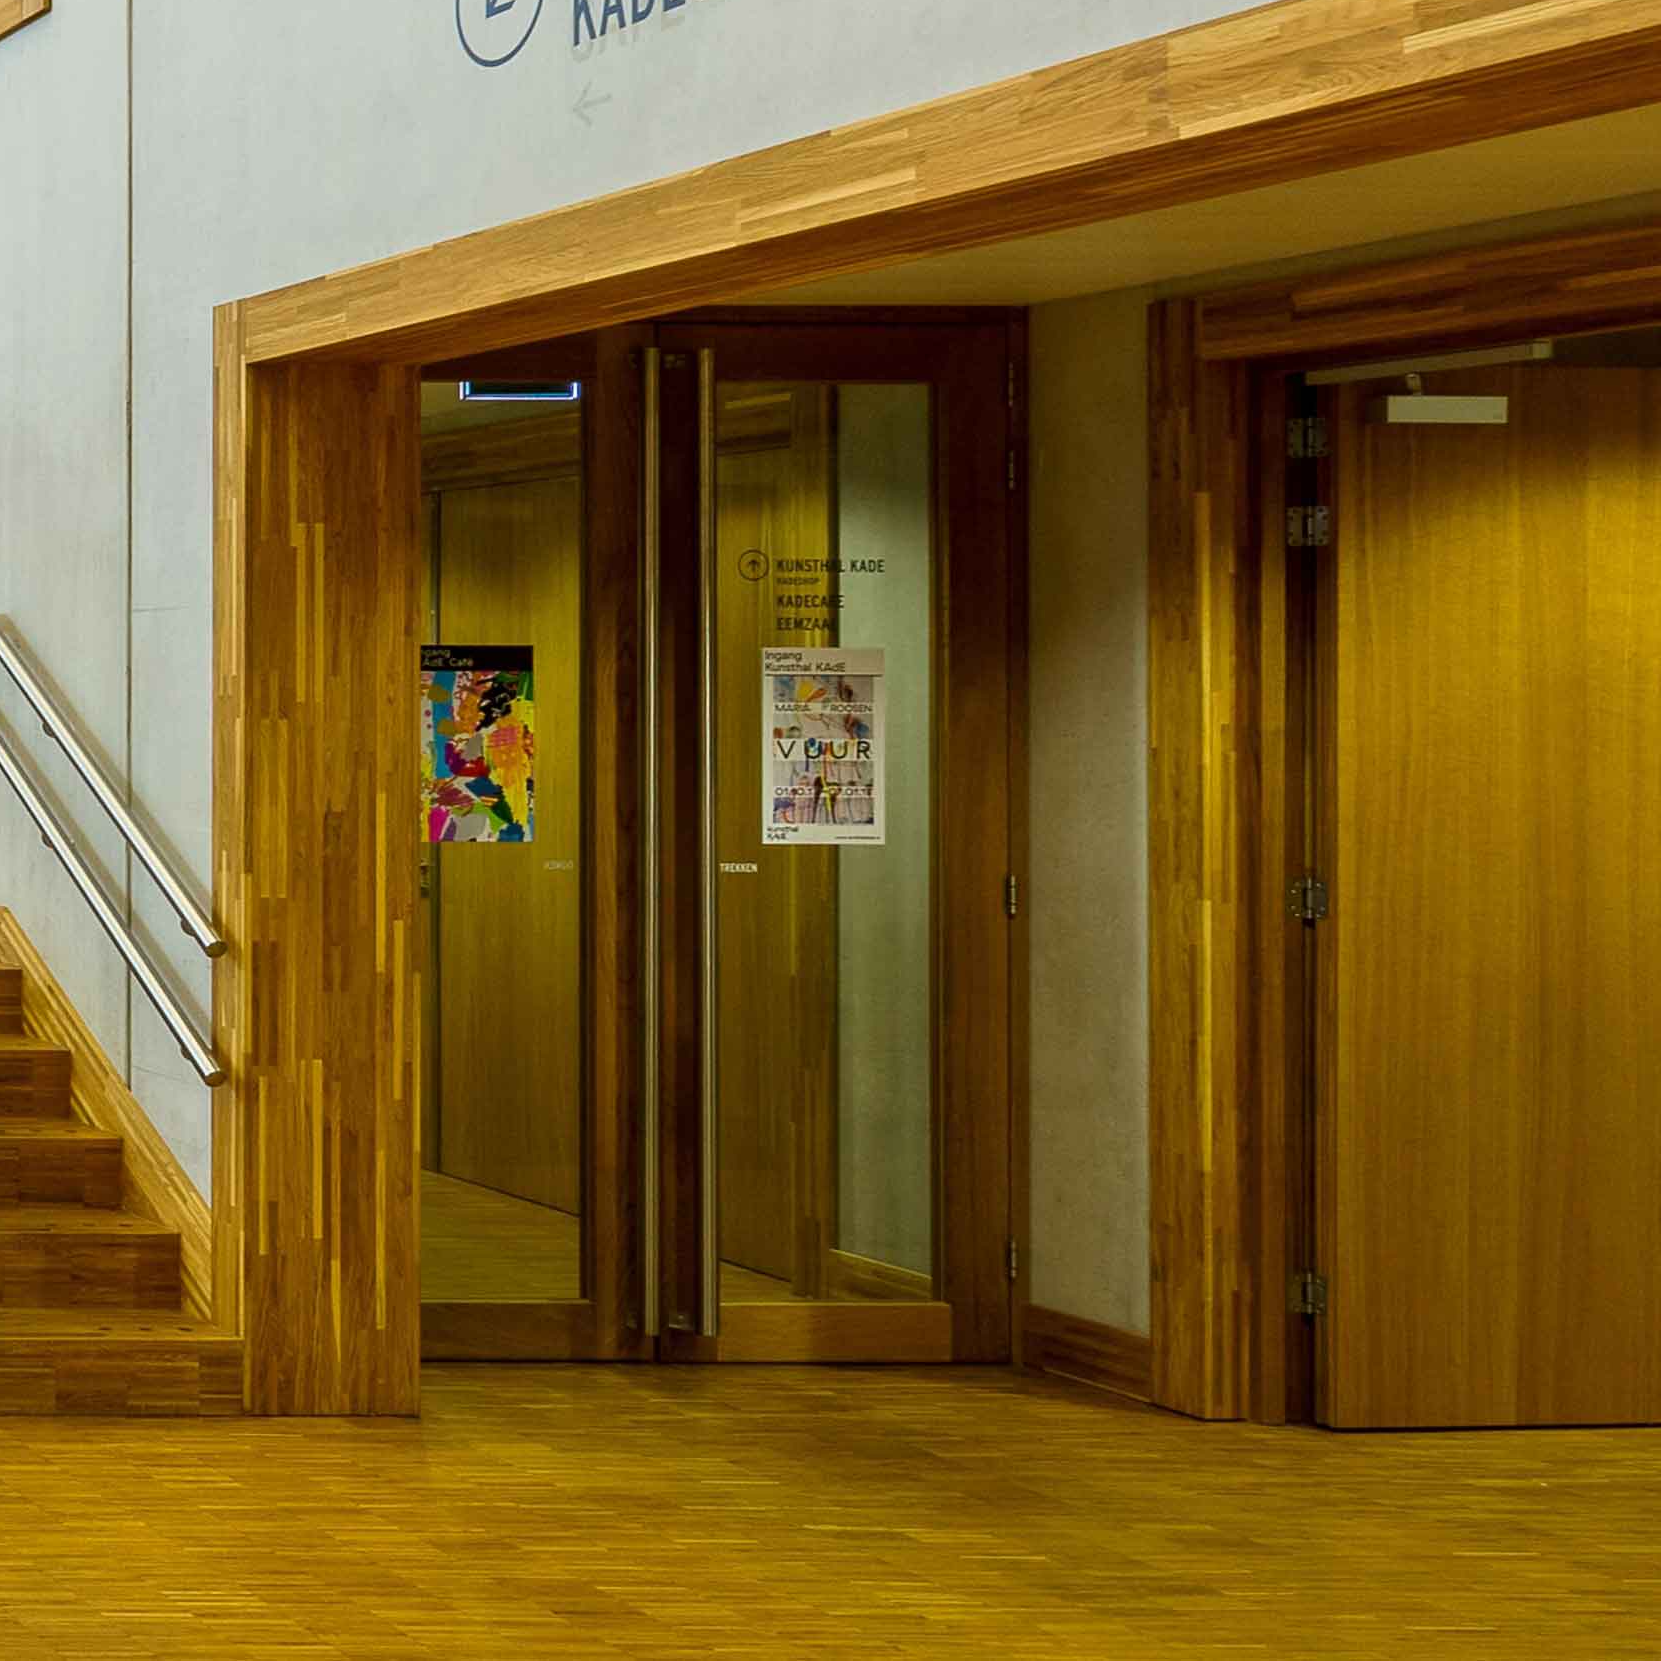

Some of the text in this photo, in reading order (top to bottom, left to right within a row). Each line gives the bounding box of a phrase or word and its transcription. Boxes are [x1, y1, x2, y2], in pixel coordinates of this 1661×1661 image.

[776, 559, 885, 574] KUNSTHAL KADE
[421, 649, 451, 659] ngang
[764, 650, 802, 662] Ingang
[764, 662, 813, 672] Kunsthal
[776, 739, 871, 759] VUUR
[719, 862, 758, 873] TREKKEN
